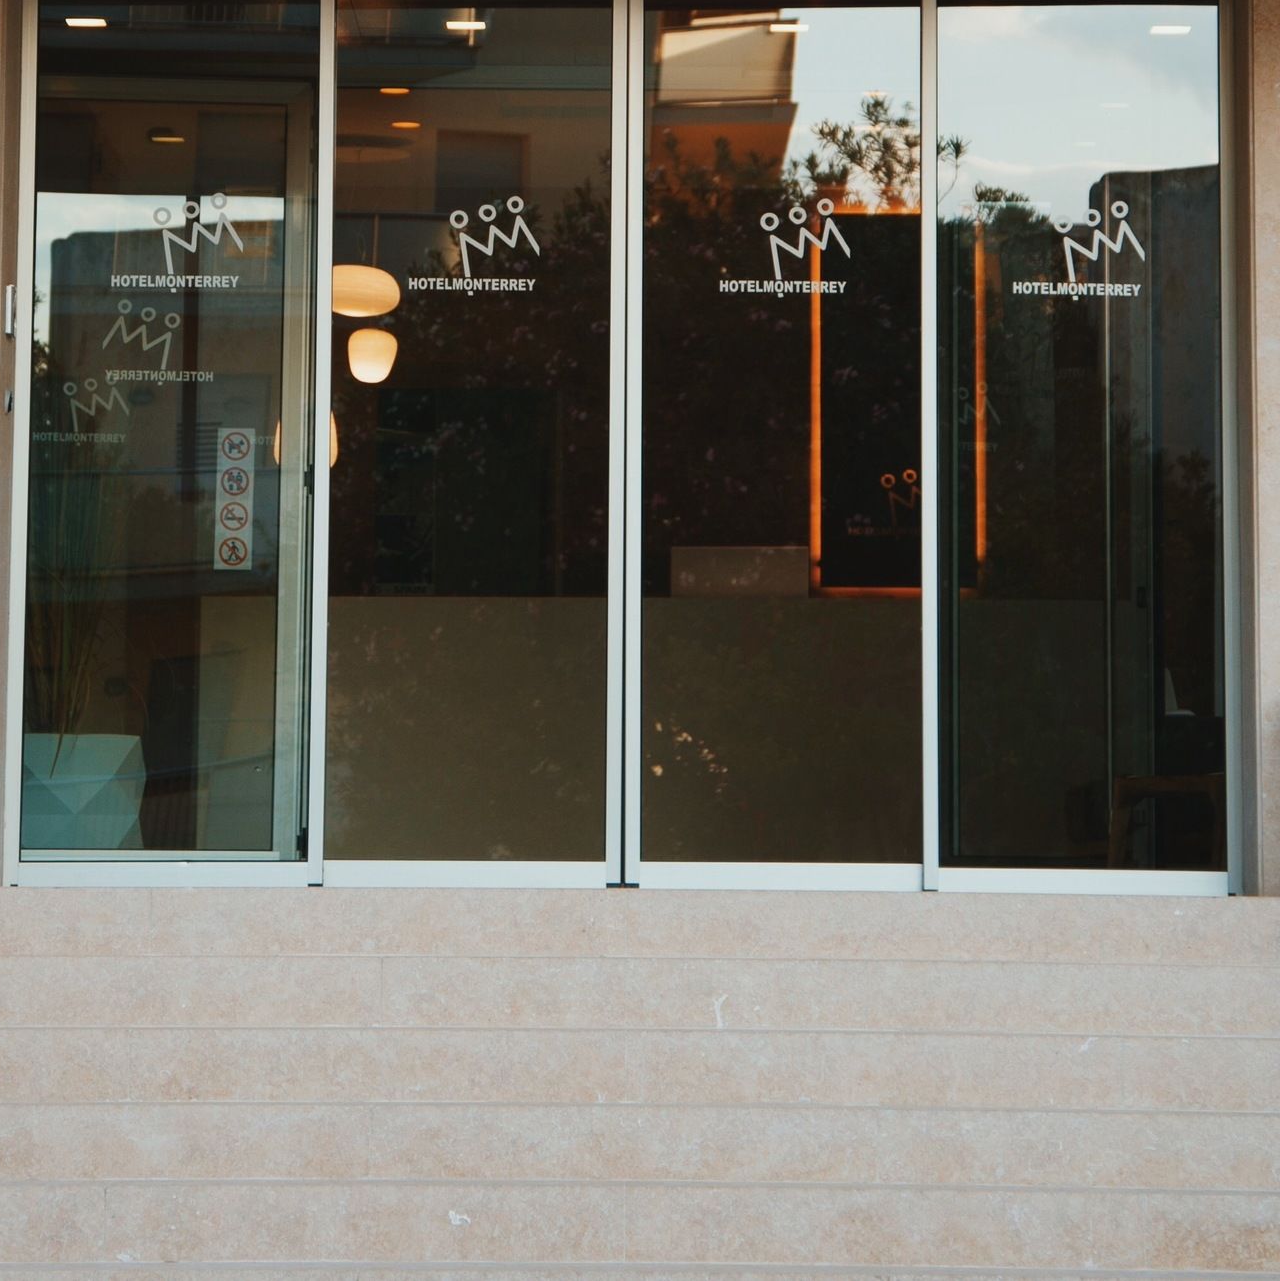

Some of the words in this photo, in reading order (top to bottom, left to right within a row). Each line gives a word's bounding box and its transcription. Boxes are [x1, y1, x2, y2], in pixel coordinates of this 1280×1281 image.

[110, 274, 239, 289] HOTELMONTERREY
[408, 276, 536, 292] HOTELMONTERREY
[718, 279, 848, 295] HOTELMONTERREY
[1011, 281, 1142, 297] HOTELMONTERREY
